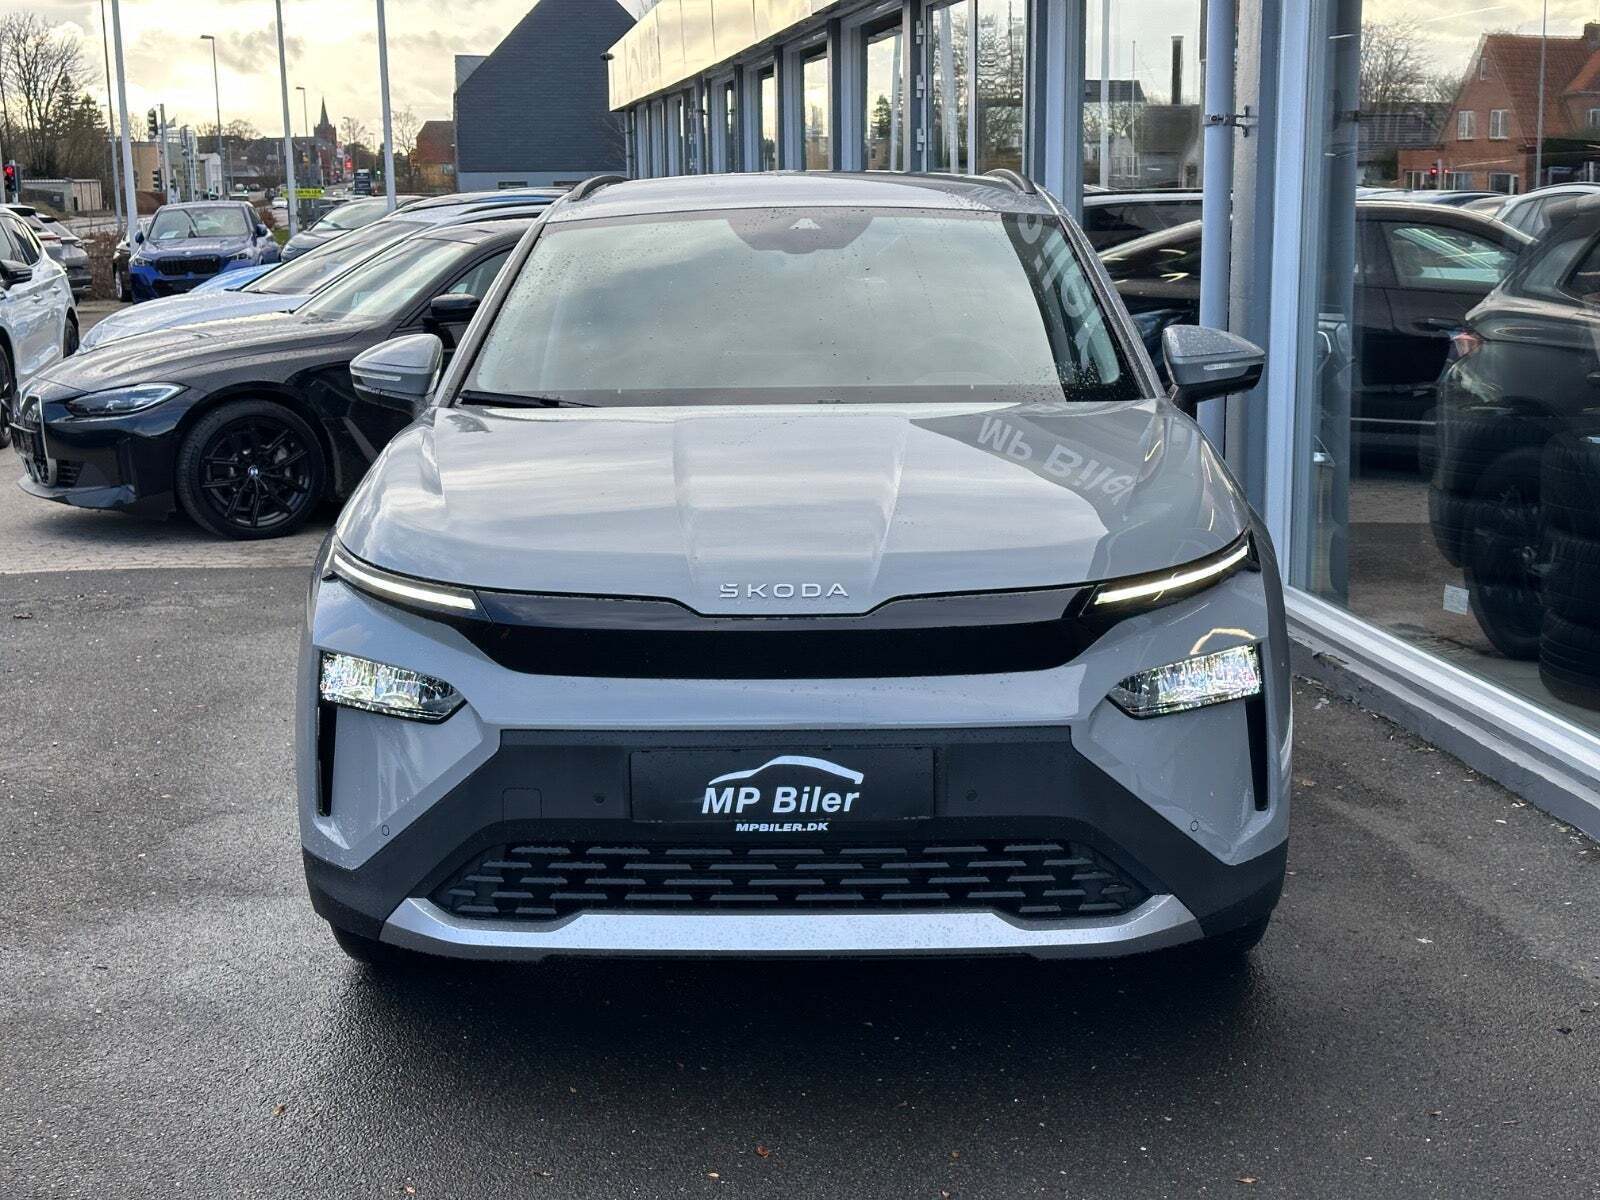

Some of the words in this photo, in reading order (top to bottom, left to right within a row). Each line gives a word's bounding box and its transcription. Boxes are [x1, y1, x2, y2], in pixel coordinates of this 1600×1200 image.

[701, 786, 761, 814] MP
[772, 785, 860, 814] Biler
[735, 822, 829, 833] MPBILER.DK
